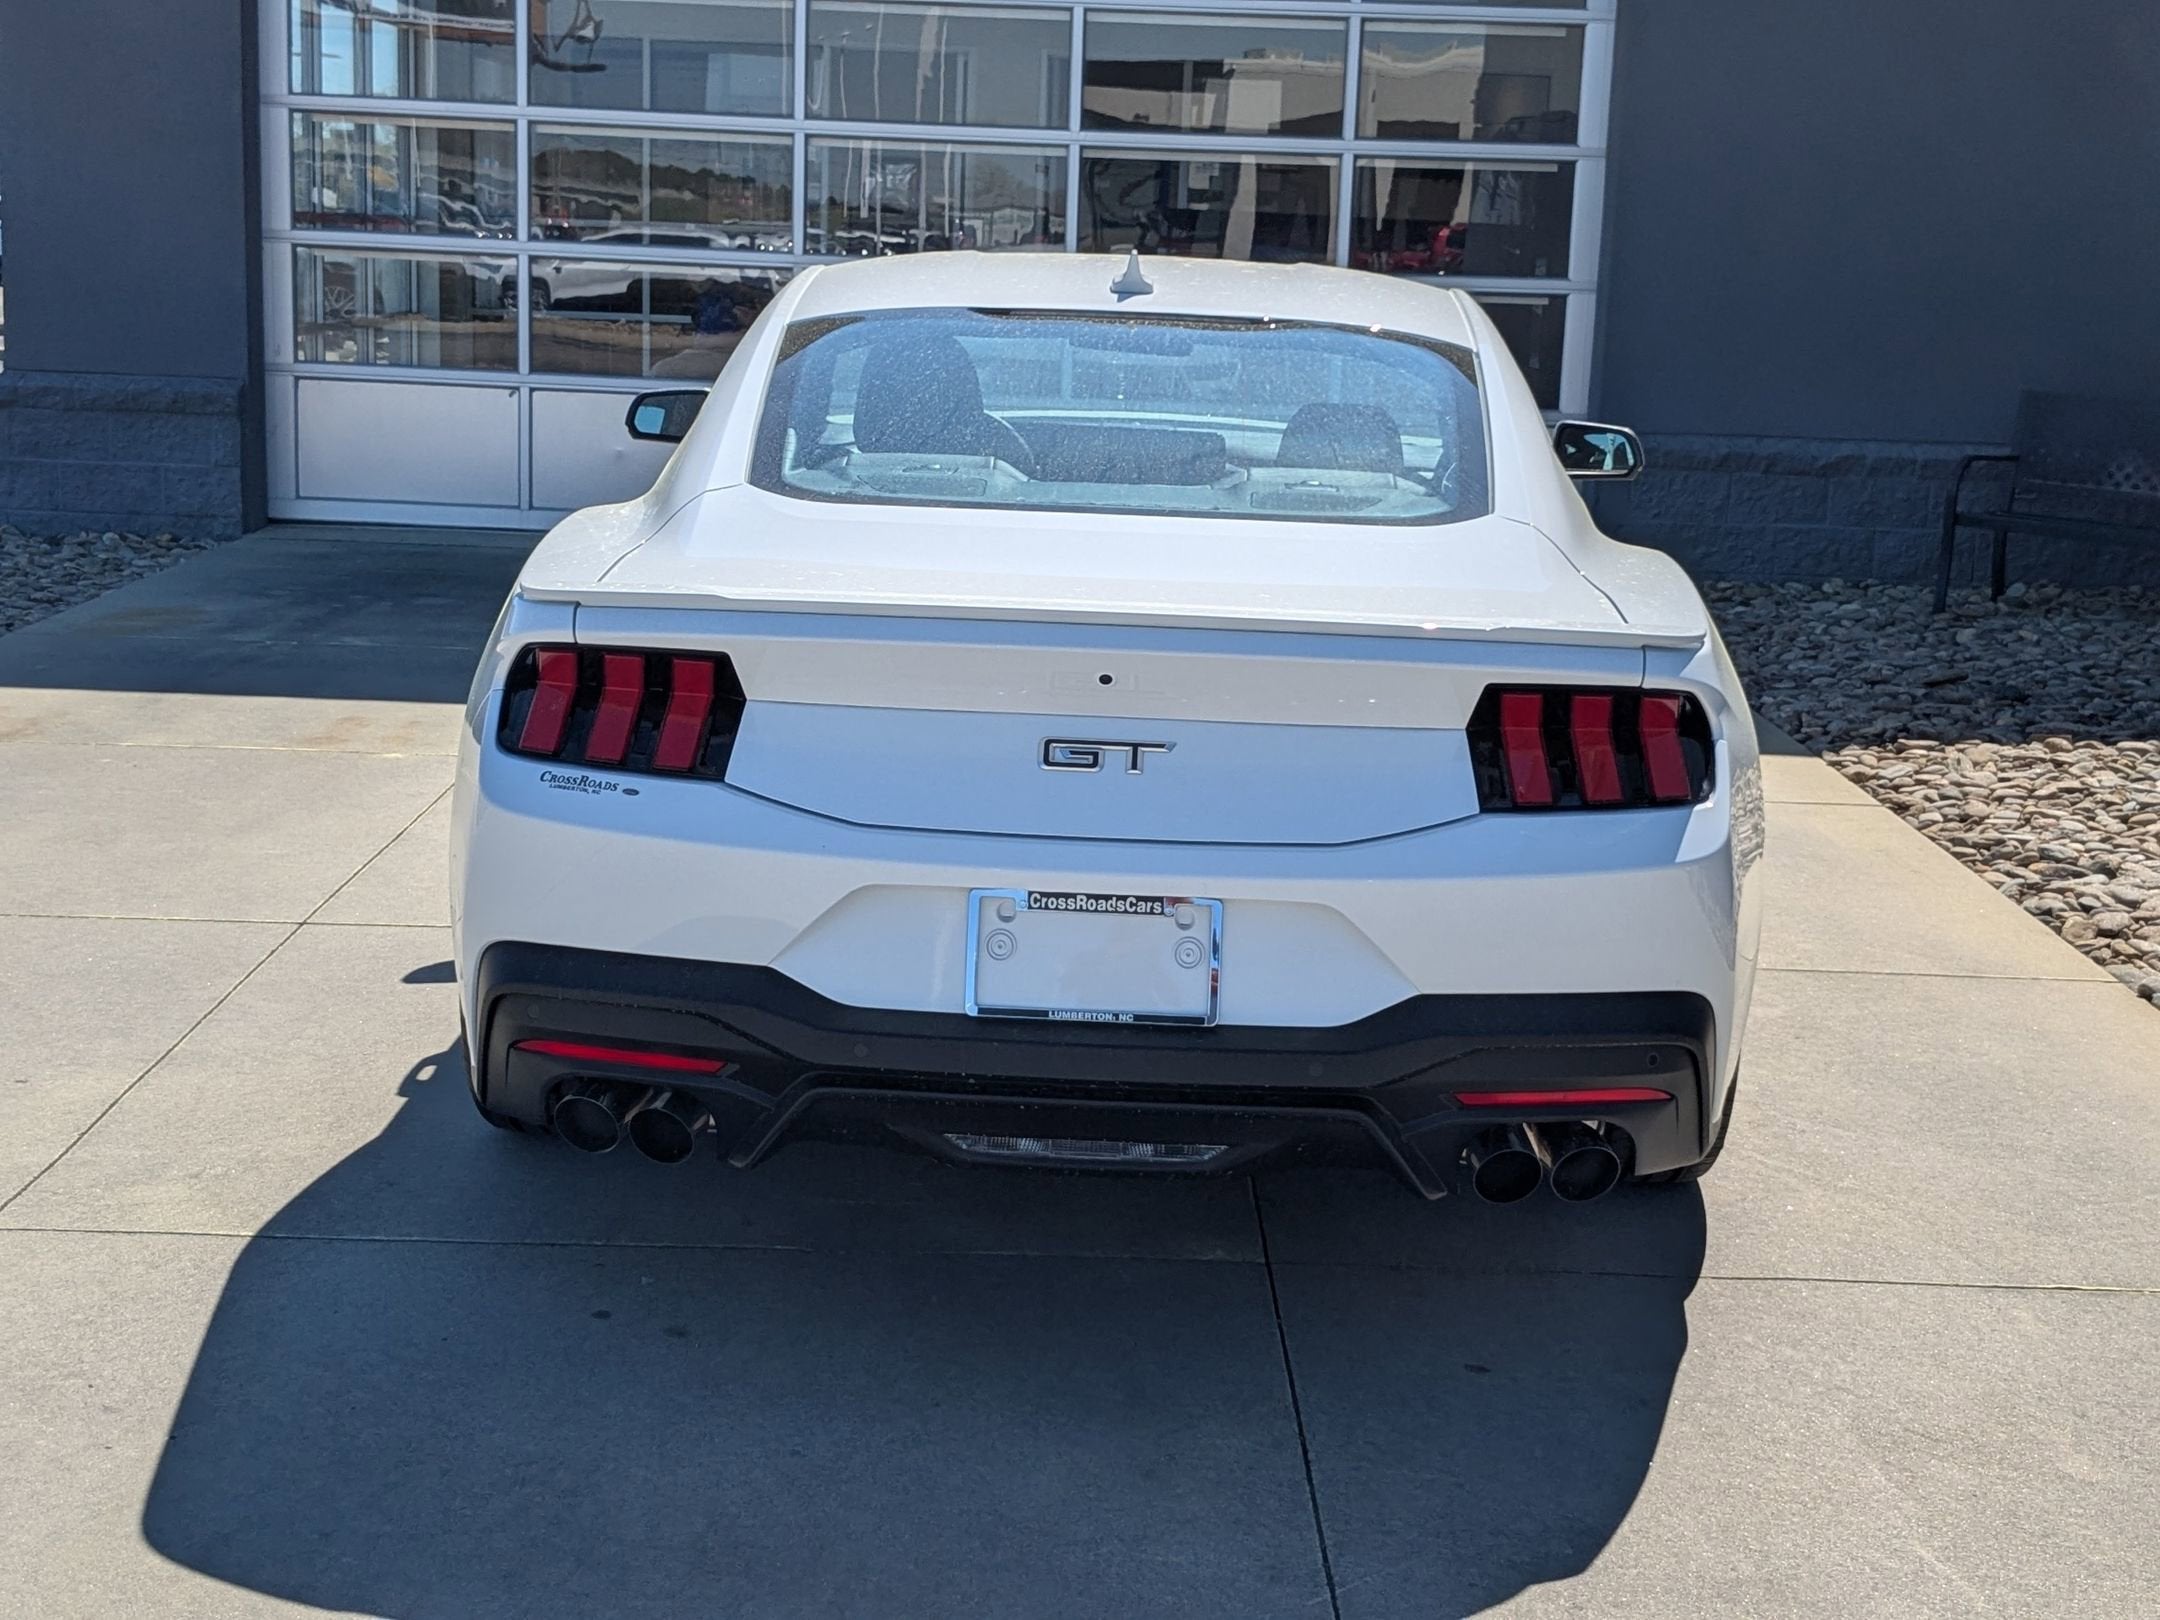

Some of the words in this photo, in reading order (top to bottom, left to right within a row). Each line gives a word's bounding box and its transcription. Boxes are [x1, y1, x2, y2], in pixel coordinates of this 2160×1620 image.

[1038, 736, 1177, 775] GT
[1029, 893, 1162, 914] CrossRoadsCars
[1118, 1013, 1135, 1023] NC
